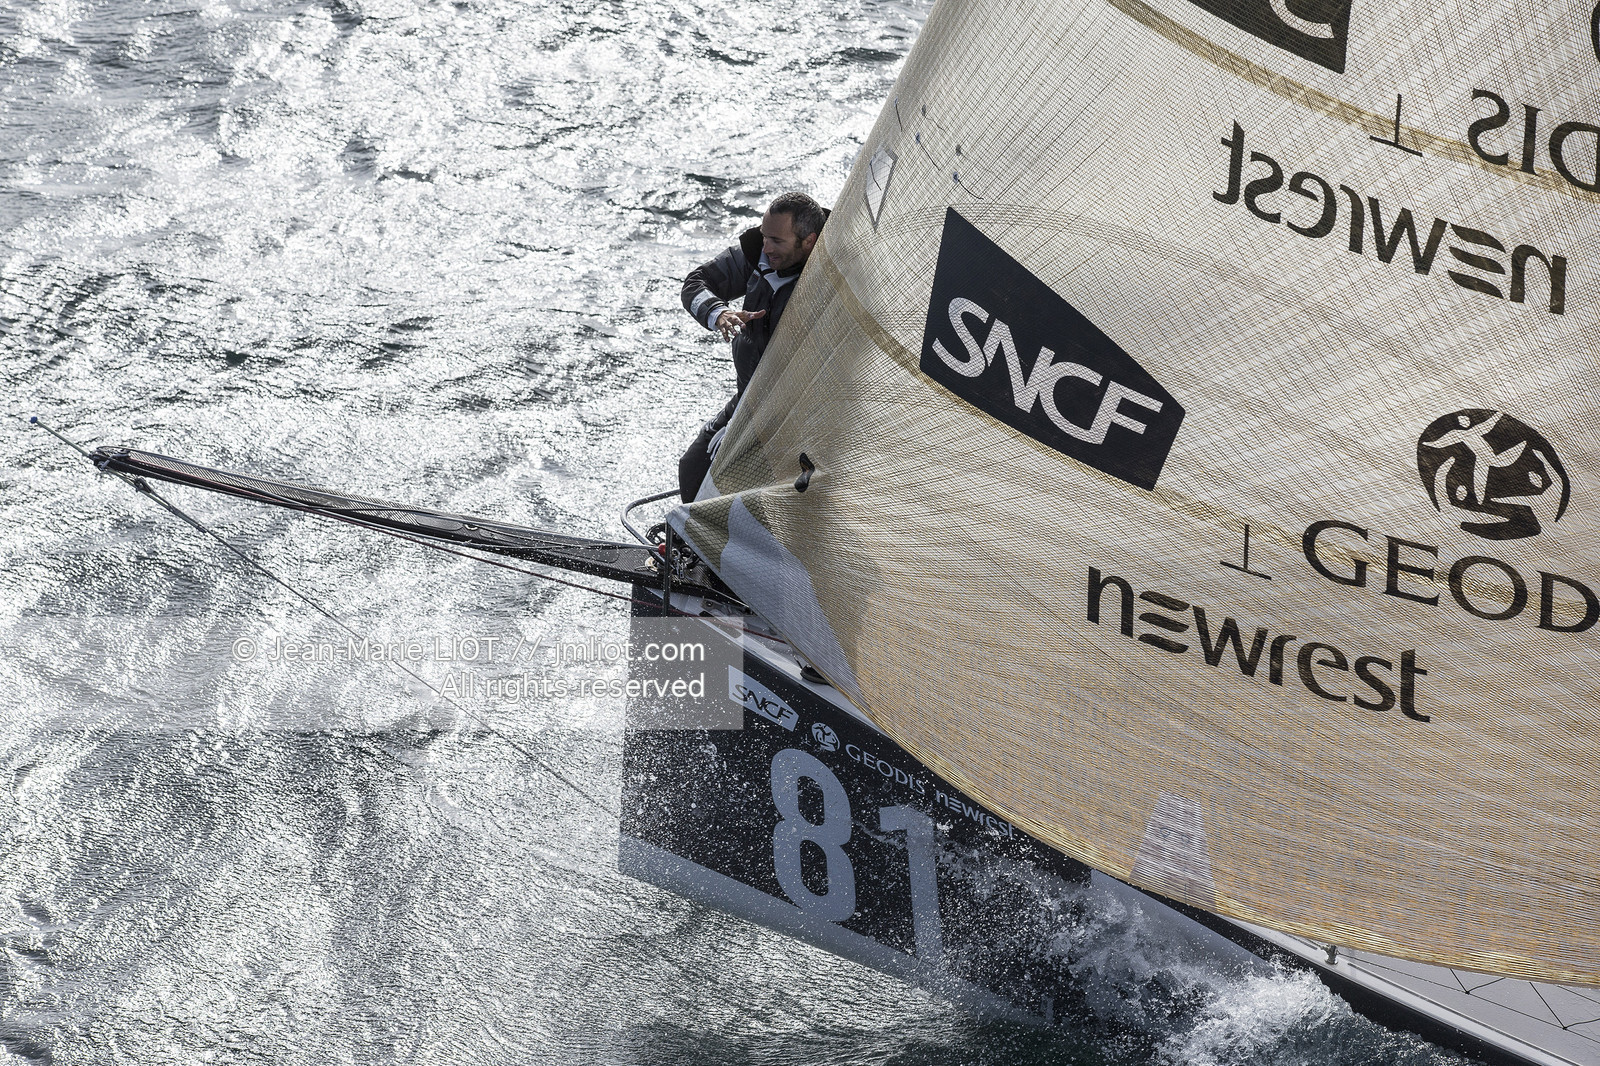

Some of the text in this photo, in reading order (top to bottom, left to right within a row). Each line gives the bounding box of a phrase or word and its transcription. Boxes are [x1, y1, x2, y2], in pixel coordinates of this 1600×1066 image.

[932, 296, 1163, 445] SNCF
[1302, 519, 1600, 633] GEOD
[732, 683, 794, 721] SNCF
[845, 743, 926, 795] GEODIS
[770, 748, 945, 962] 81
